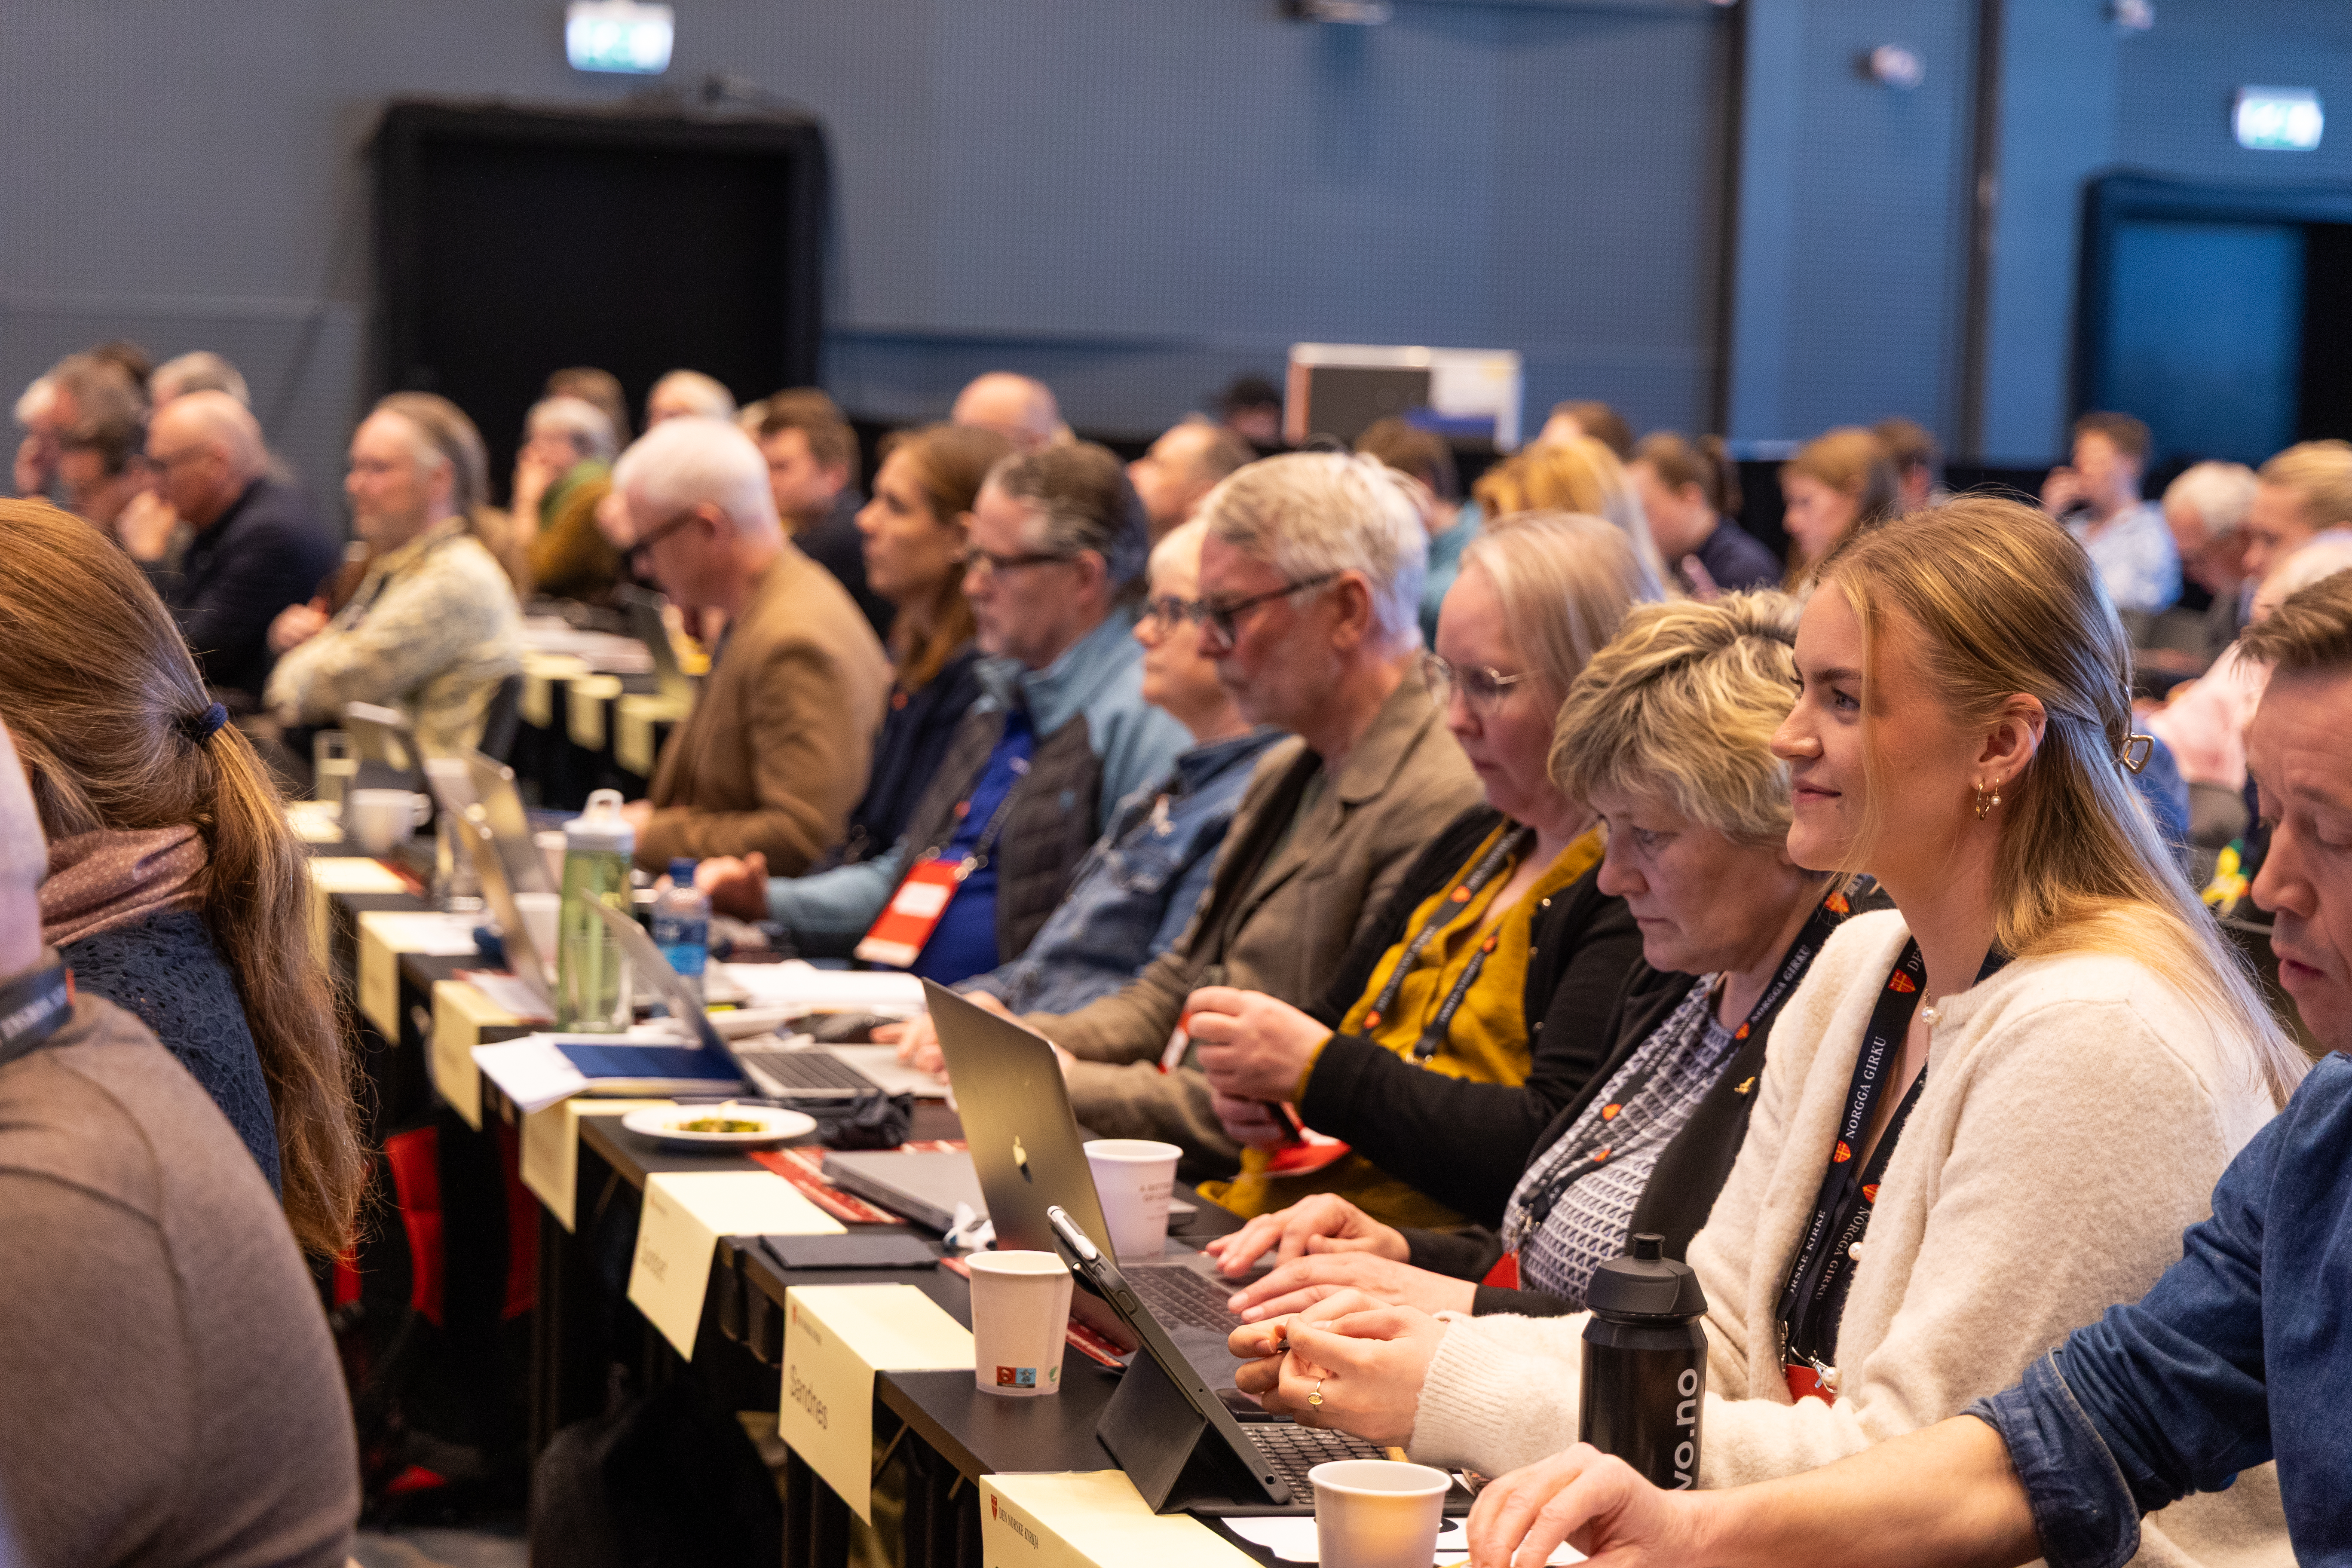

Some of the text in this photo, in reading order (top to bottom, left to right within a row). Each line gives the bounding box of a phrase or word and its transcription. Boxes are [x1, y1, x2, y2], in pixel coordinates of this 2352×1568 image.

[1845, 1036, 1886, 1139] NORGGA GIRKU
[1806, 1210, 1825, 1251] KIRKE
[1815, 1206, 1871, 1300] NORGGA GIRKU
[1008, 1514, 1023, 1537] NORSKE
[1025, 1527, 1038, 1550] KYRKJA
